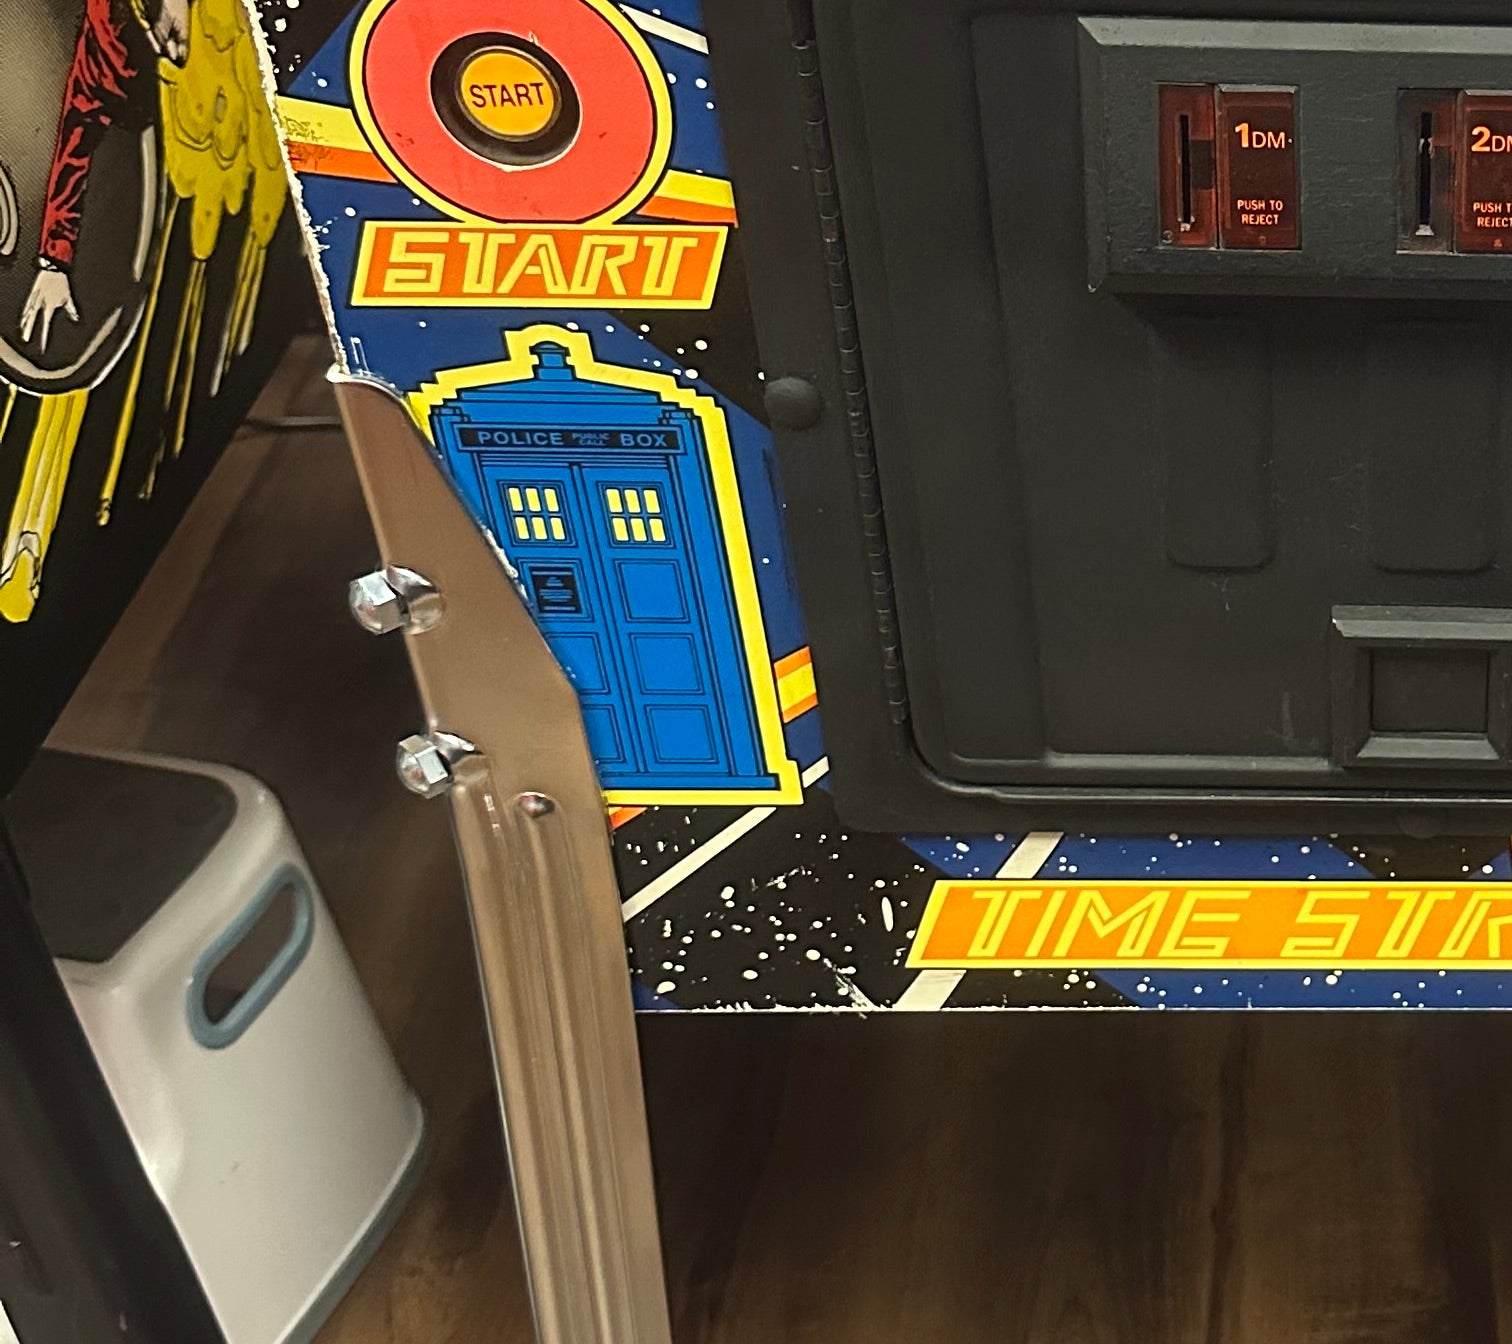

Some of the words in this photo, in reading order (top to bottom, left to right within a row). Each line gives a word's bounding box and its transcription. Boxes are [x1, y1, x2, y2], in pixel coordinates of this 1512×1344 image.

[469, 81, 546, 110] START
[1237, 200, 1265, 211] PUSH
[1270, 200, 1283, 211] TO
[1473, 202, 1502, 213] PUSH
[1241, 214, 1279, 225] REJECT
[383, 231, 698, 296] START
[477, 431, 564, 446] POLICE
[620, 433, 668, 447] BOX
[578, 439, 606, 447] CALL
[967, 890, 1252, 958] TIME
